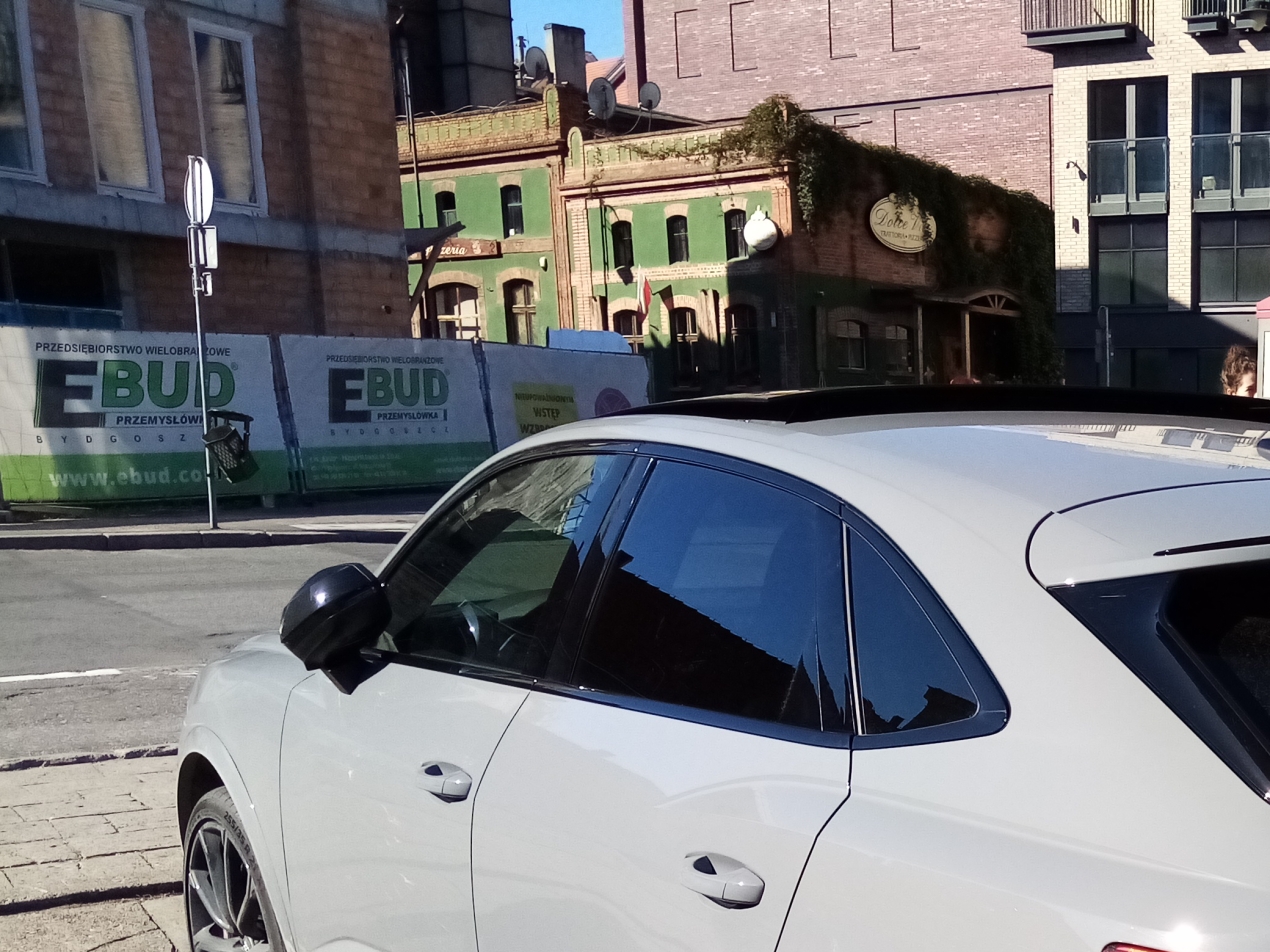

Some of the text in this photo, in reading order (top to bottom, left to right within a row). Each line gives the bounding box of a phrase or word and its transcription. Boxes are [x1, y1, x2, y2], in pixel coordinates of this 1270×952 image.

[425, 244, 467, 259] Pzeria
[35, 342, 143, 356] PRZEDSIĘBIORSTWO
[326, 355, 391, 364] PRZEDSIĘBIORSTWO
[34, 359, 236, 428] EBUD
[328, 368, 450, 423] EBUD
[377, 411, 439, 420] PRZEMYSŁÓWKA
[533, 407, 560, 420] WSTĘP
[48, 467, 205, 488] www.ebud.co
